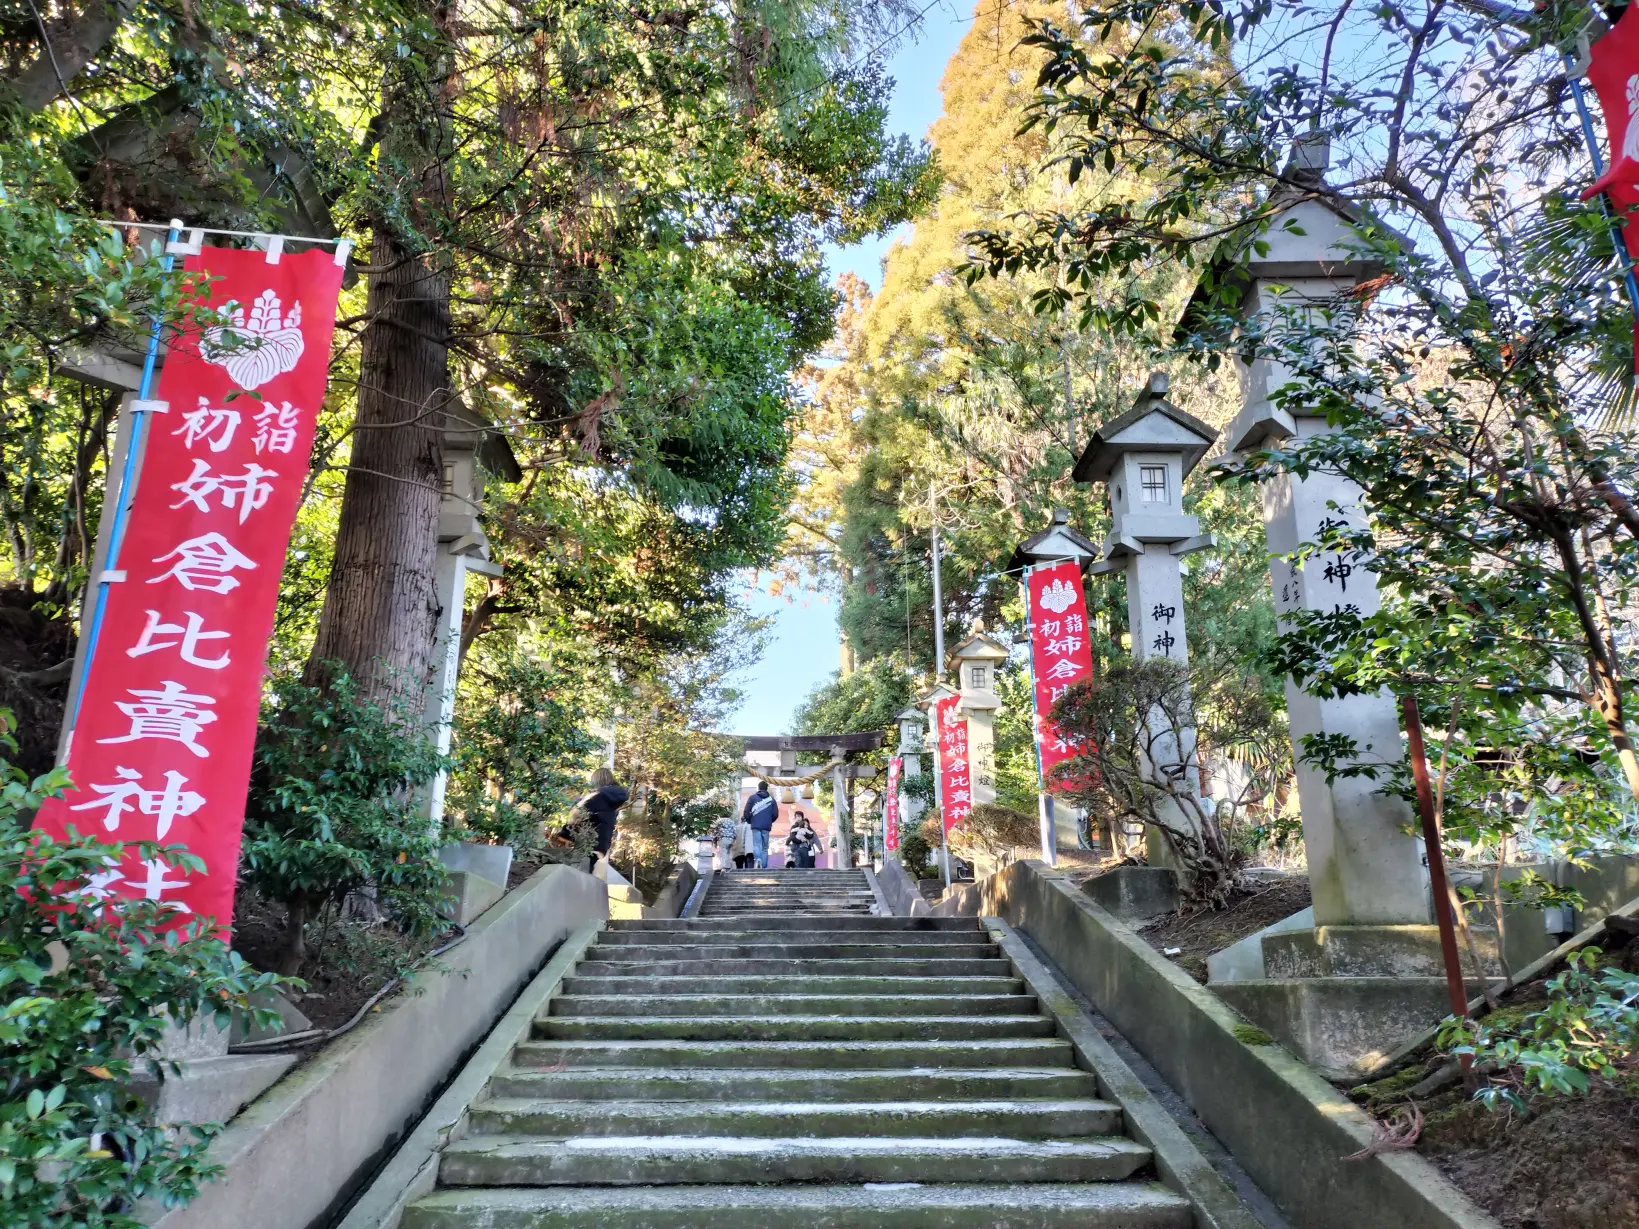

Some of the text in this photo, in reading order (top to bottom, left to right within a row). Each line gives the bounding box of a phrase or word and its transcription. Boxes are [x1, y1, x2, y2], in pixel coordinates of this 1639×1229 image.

[171, 396, 305, 455] 初詣
[1038, 613, 1083, 637] 初詣
[1151, 602, 1176, 657] 御神
